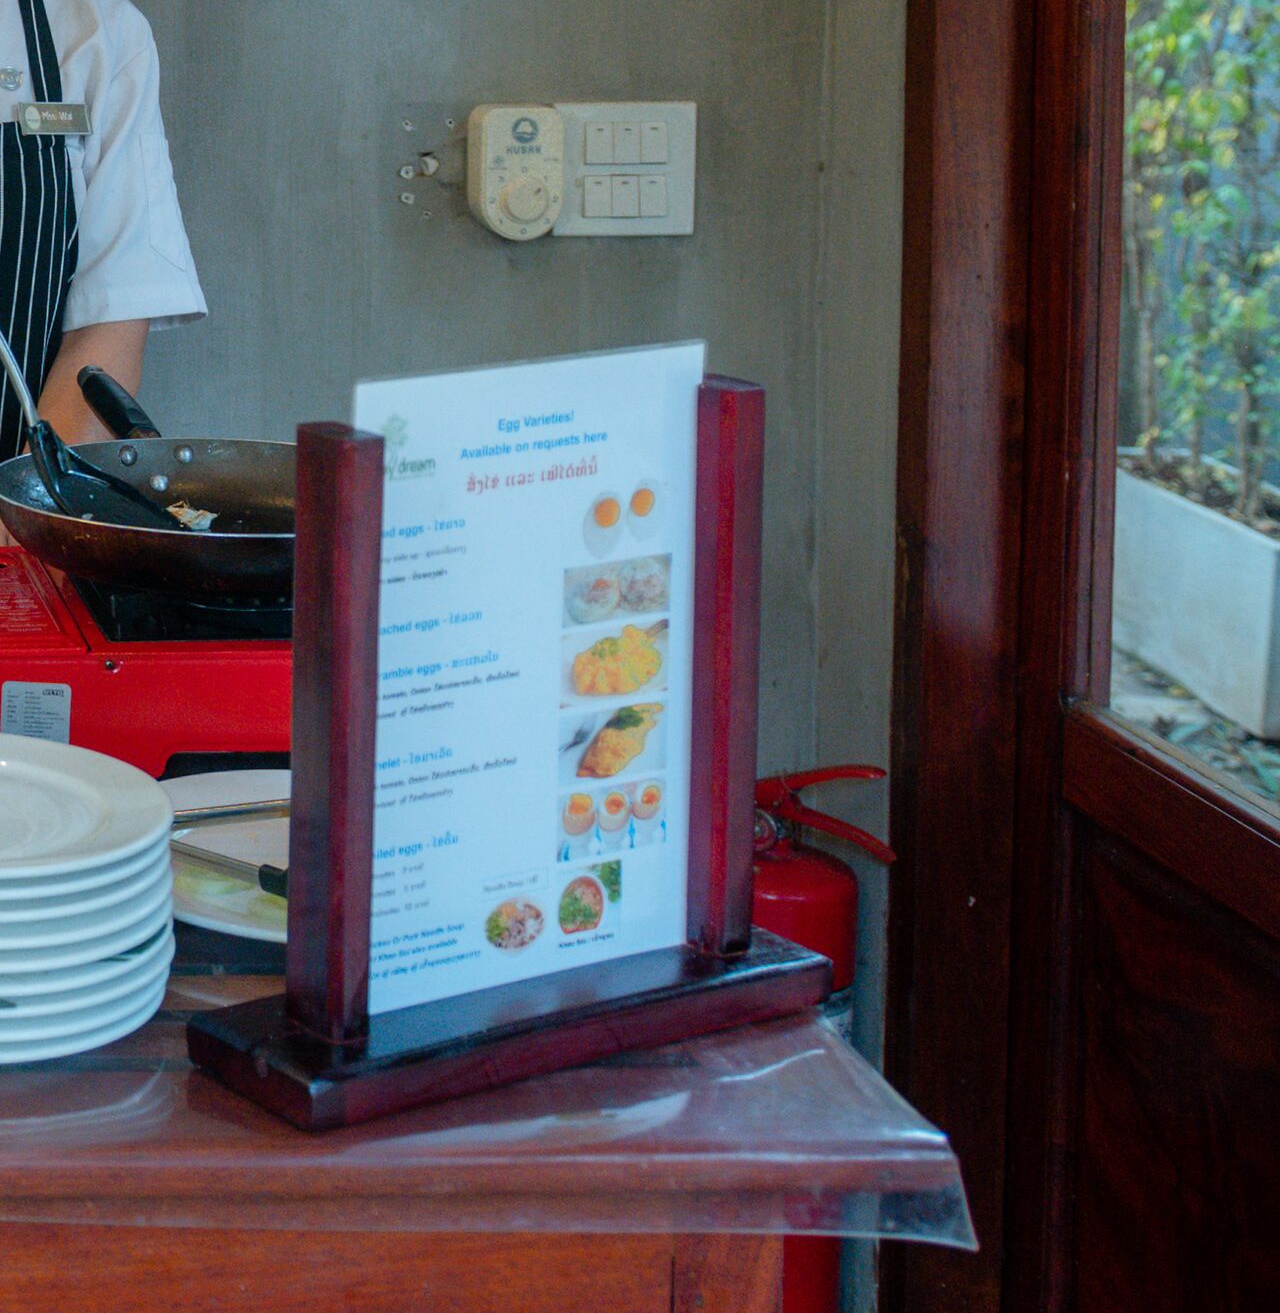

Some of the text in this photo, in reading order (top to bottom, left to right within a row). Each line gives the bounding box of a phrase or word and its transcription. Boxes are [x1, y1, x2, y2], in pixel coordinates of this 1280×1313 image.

[498, 410, 575, 433] Egg Varieties!
[460, 431, 608, 460] Available on requests here
[397, 456, 436, 475] dream
[382, 527, 396, 539] ed
[399, 524, 425, 538] eggs
[380, 620, 413, 636] ached
[415, 617, 441, 633] eggs
[416, 662, 442, 677] eggs
[398, 843, 423, 857] eggs
